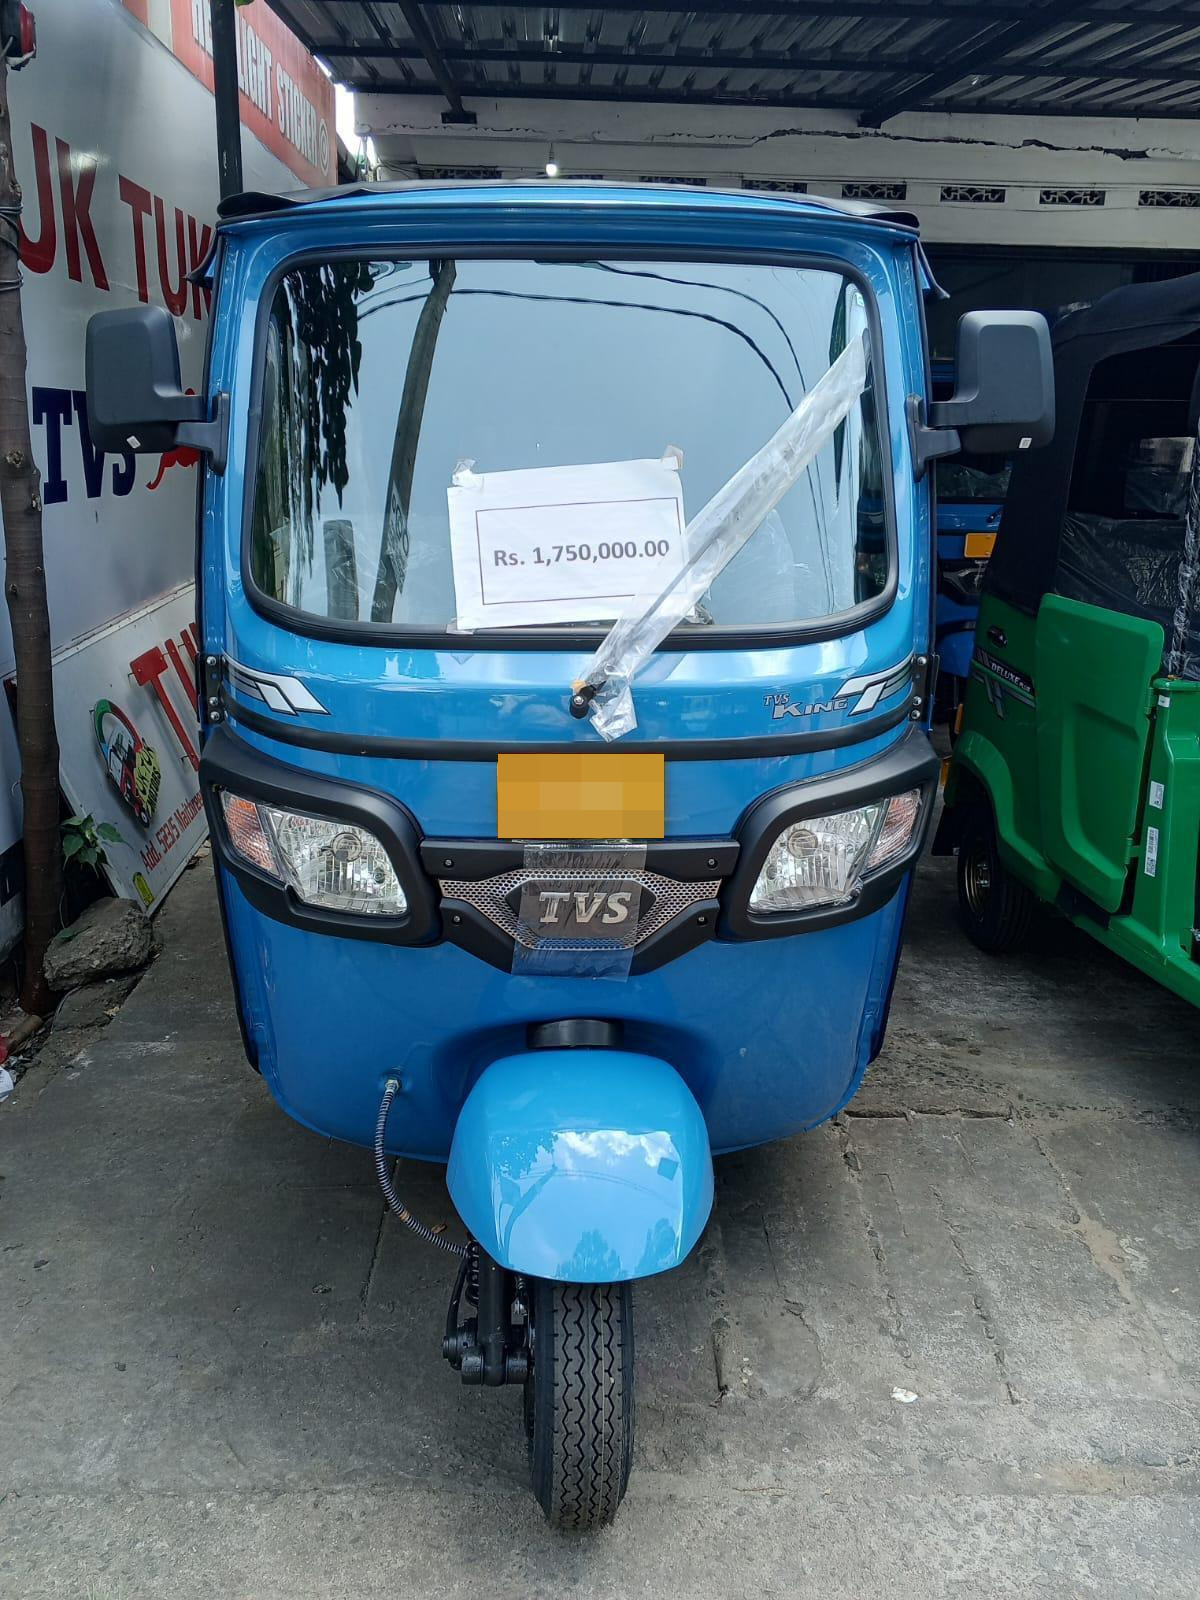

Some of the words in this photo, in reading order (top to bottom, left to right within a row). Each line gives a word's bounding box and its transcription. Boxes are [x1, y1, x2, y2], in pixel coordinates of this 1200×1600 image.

[276, 61, 319, 169] STICKER
[493, 549, 526, 567] Rs.
[532, 539, 670, 567] 1,750,000.00
[991, 662, 1021, 685] DELUXE
[763, 692, 790, 707] TVS
[538, 891, 631, 924] TVS
